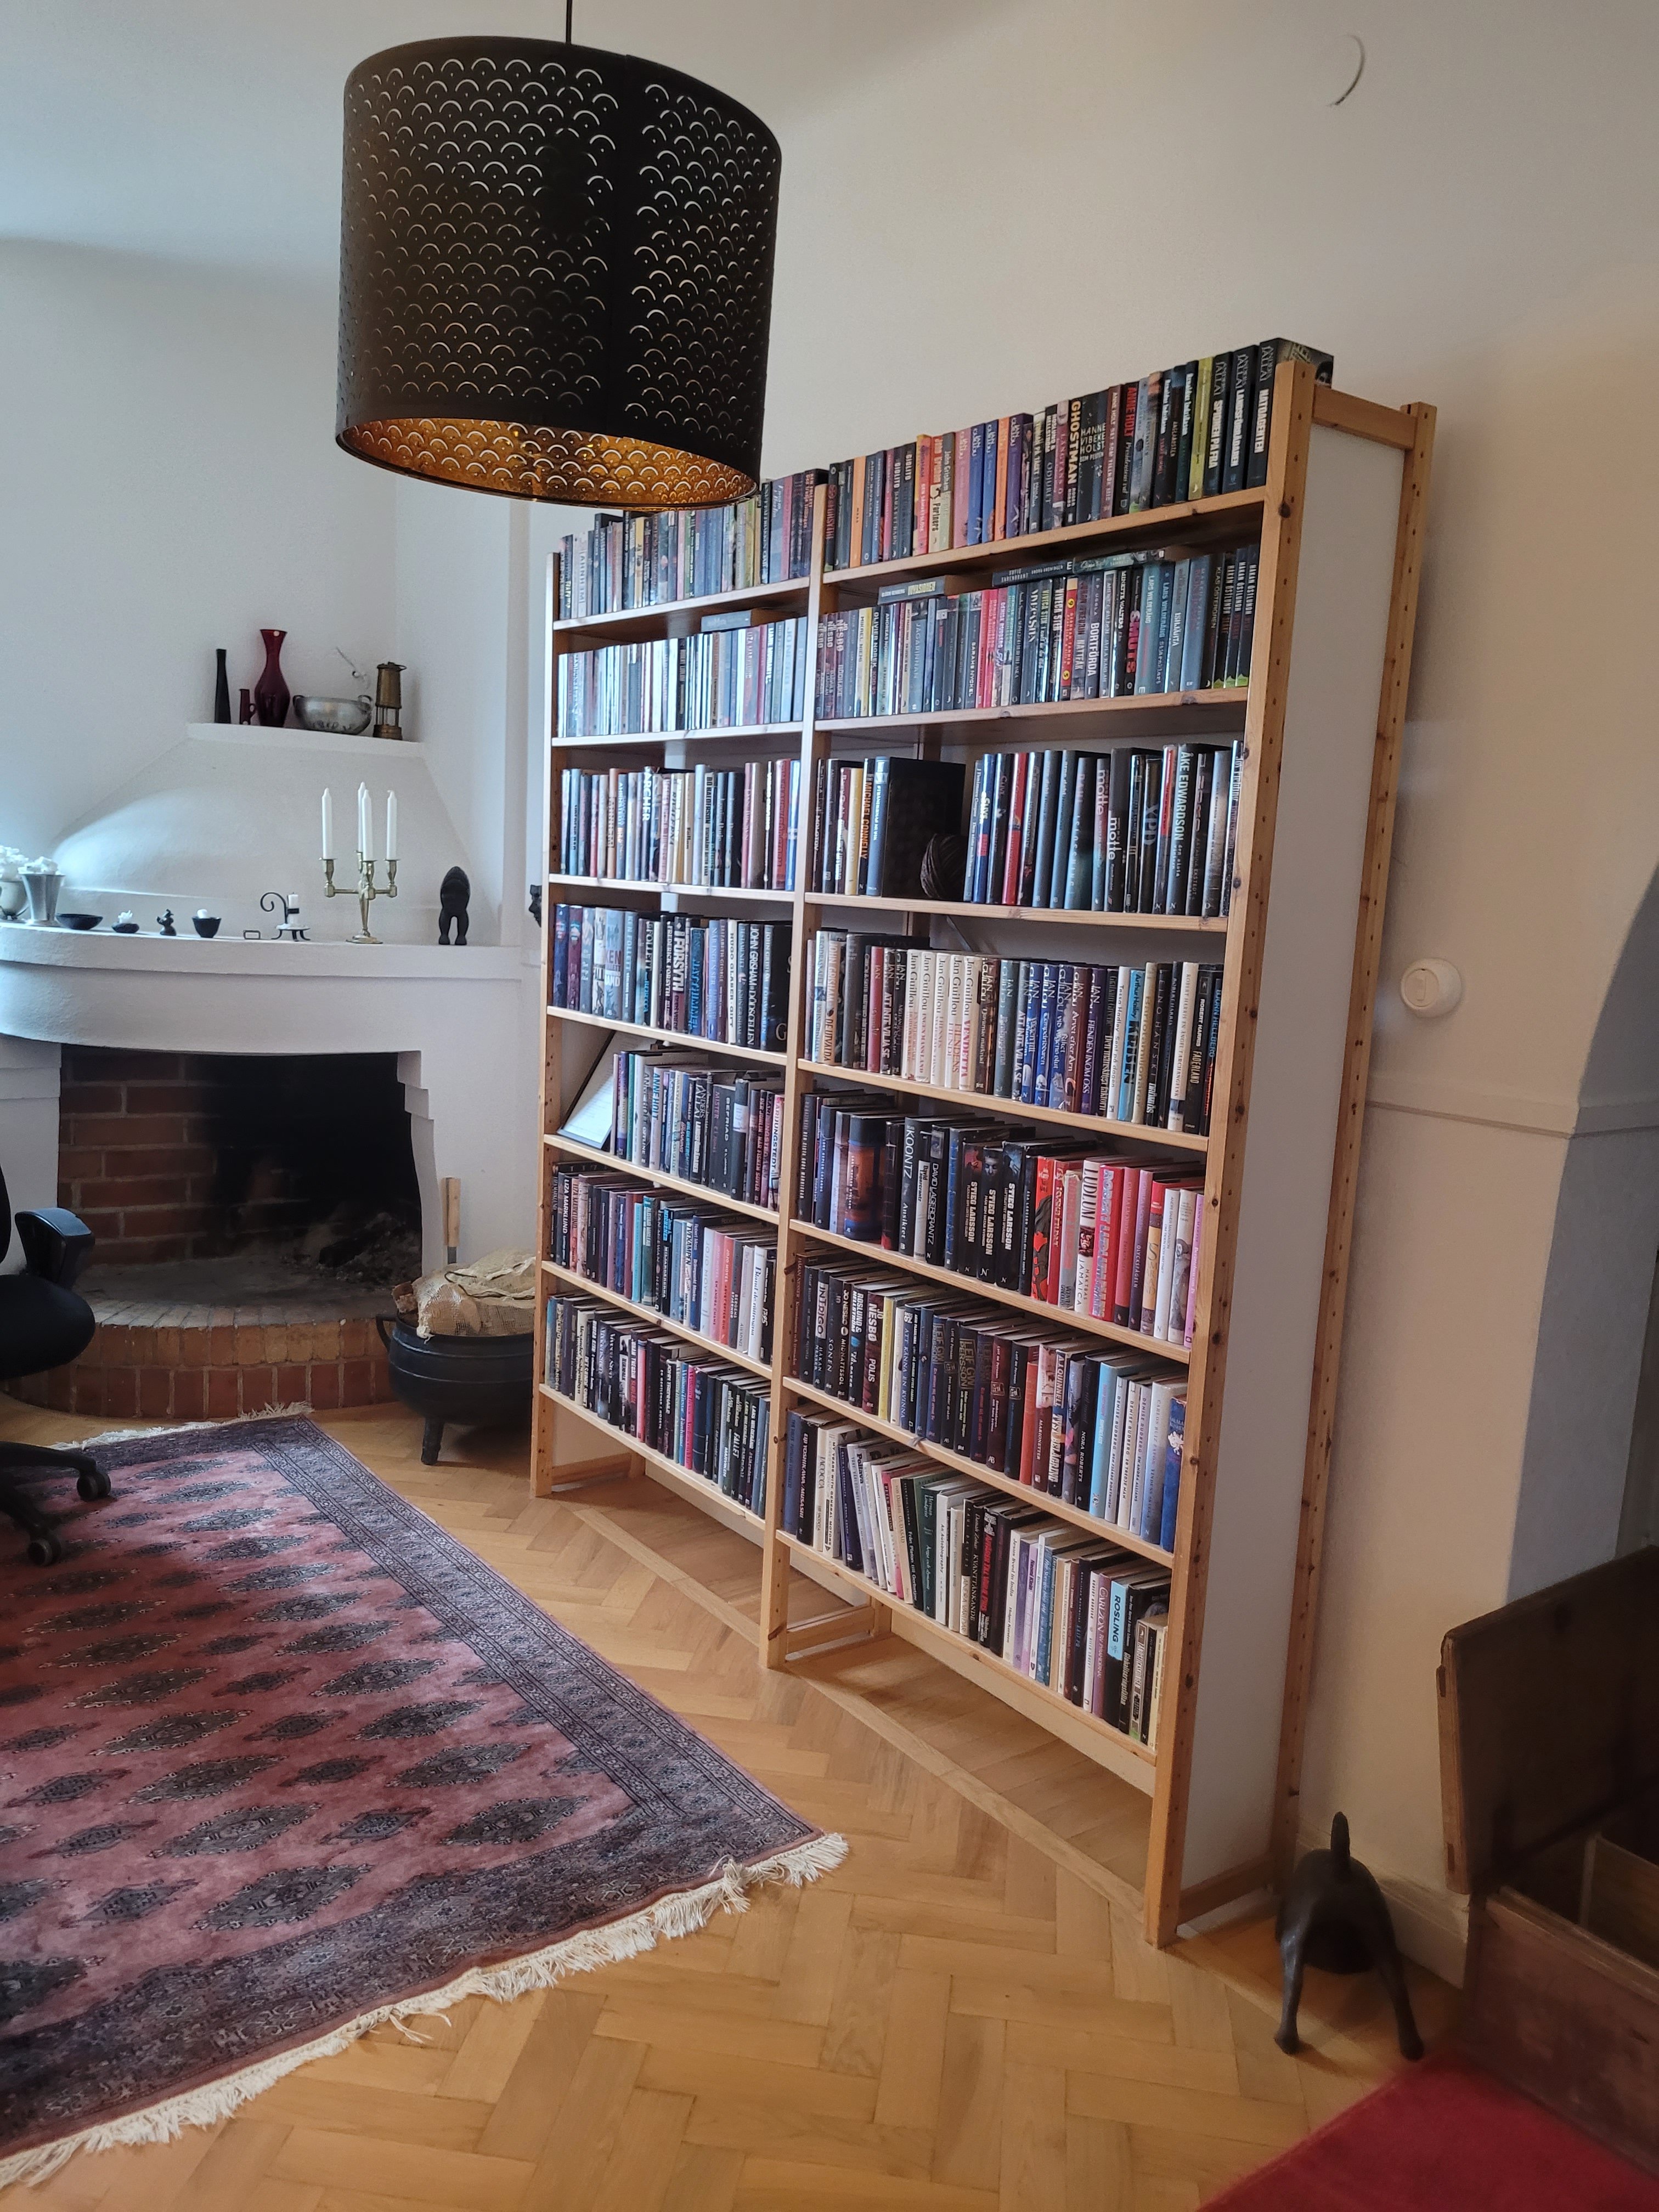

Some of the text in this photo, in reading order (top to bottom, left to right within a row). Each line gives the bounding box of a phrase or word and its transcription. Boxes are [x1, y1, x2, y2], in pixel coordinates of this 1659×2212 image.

[1081, 423, 1106, 437] HANNE
[1125, 387, 1136, 437] ANNE HOLT
[1254, 389, 1269, 453] NATOAGENTEN
[1068, 400, 1080, 484] GHOSTMAN
[1080, 441, 1104, 454] HOLST
[1081, 432, 1105, 445] VIBEKE
[932, 503, 940, 532] Partners
[1053, 589, 1064, 631] VIVECA STEN
[1087, 623, 1099, 676] BORTFÖRDA
[1126, 611, 1140, 673] SMUTS
[642, 772, 651, 821] ARCHER
[1175, 752, 1193, 840] ÅKE EDWARDSON
[860, 782, 872, 859] MICHAEL CONNELLY
[1107, 818, 1121, 860] motte
[1144, 804, 1158, 845] XPD
[750, 927, 759, 949] JOHN
[673, 938, 685, 991] FORSYTH
[922, 955, 931, 1009] Jan Guillou
[951, 957, 962, 1016] Jan Guillou
[1133, 974, 1142, 995] Arthur
[909, 970, 917, 1008] Guillou
[936, 977, 945, 1013] Guillou
[961, 958, 974, 1077] Jan Guillou VENDETTA
[1086, 1019, 1094, 1054] FIENDEN
[1084, 1055, 1092, 1076] INOM
[1124, 1020, 1139, 1084] KRISEN
[1190, 1051, 1201, 1084] FADERLAND
[904, 1130, 915, 1179] KOONTZ
[928, 1187, 938, 1244] LAGERCRANTZ
[1081, 1168, 1098, 1220] LUDLUM
[985, 1216, 994, 1255] LARSSON
[1005, 1210, 1013, 1250] LARSSON
[868, 1303, 877, 1341] NESBØ
[1113, 1595, 1121, 1642] ROSLING
